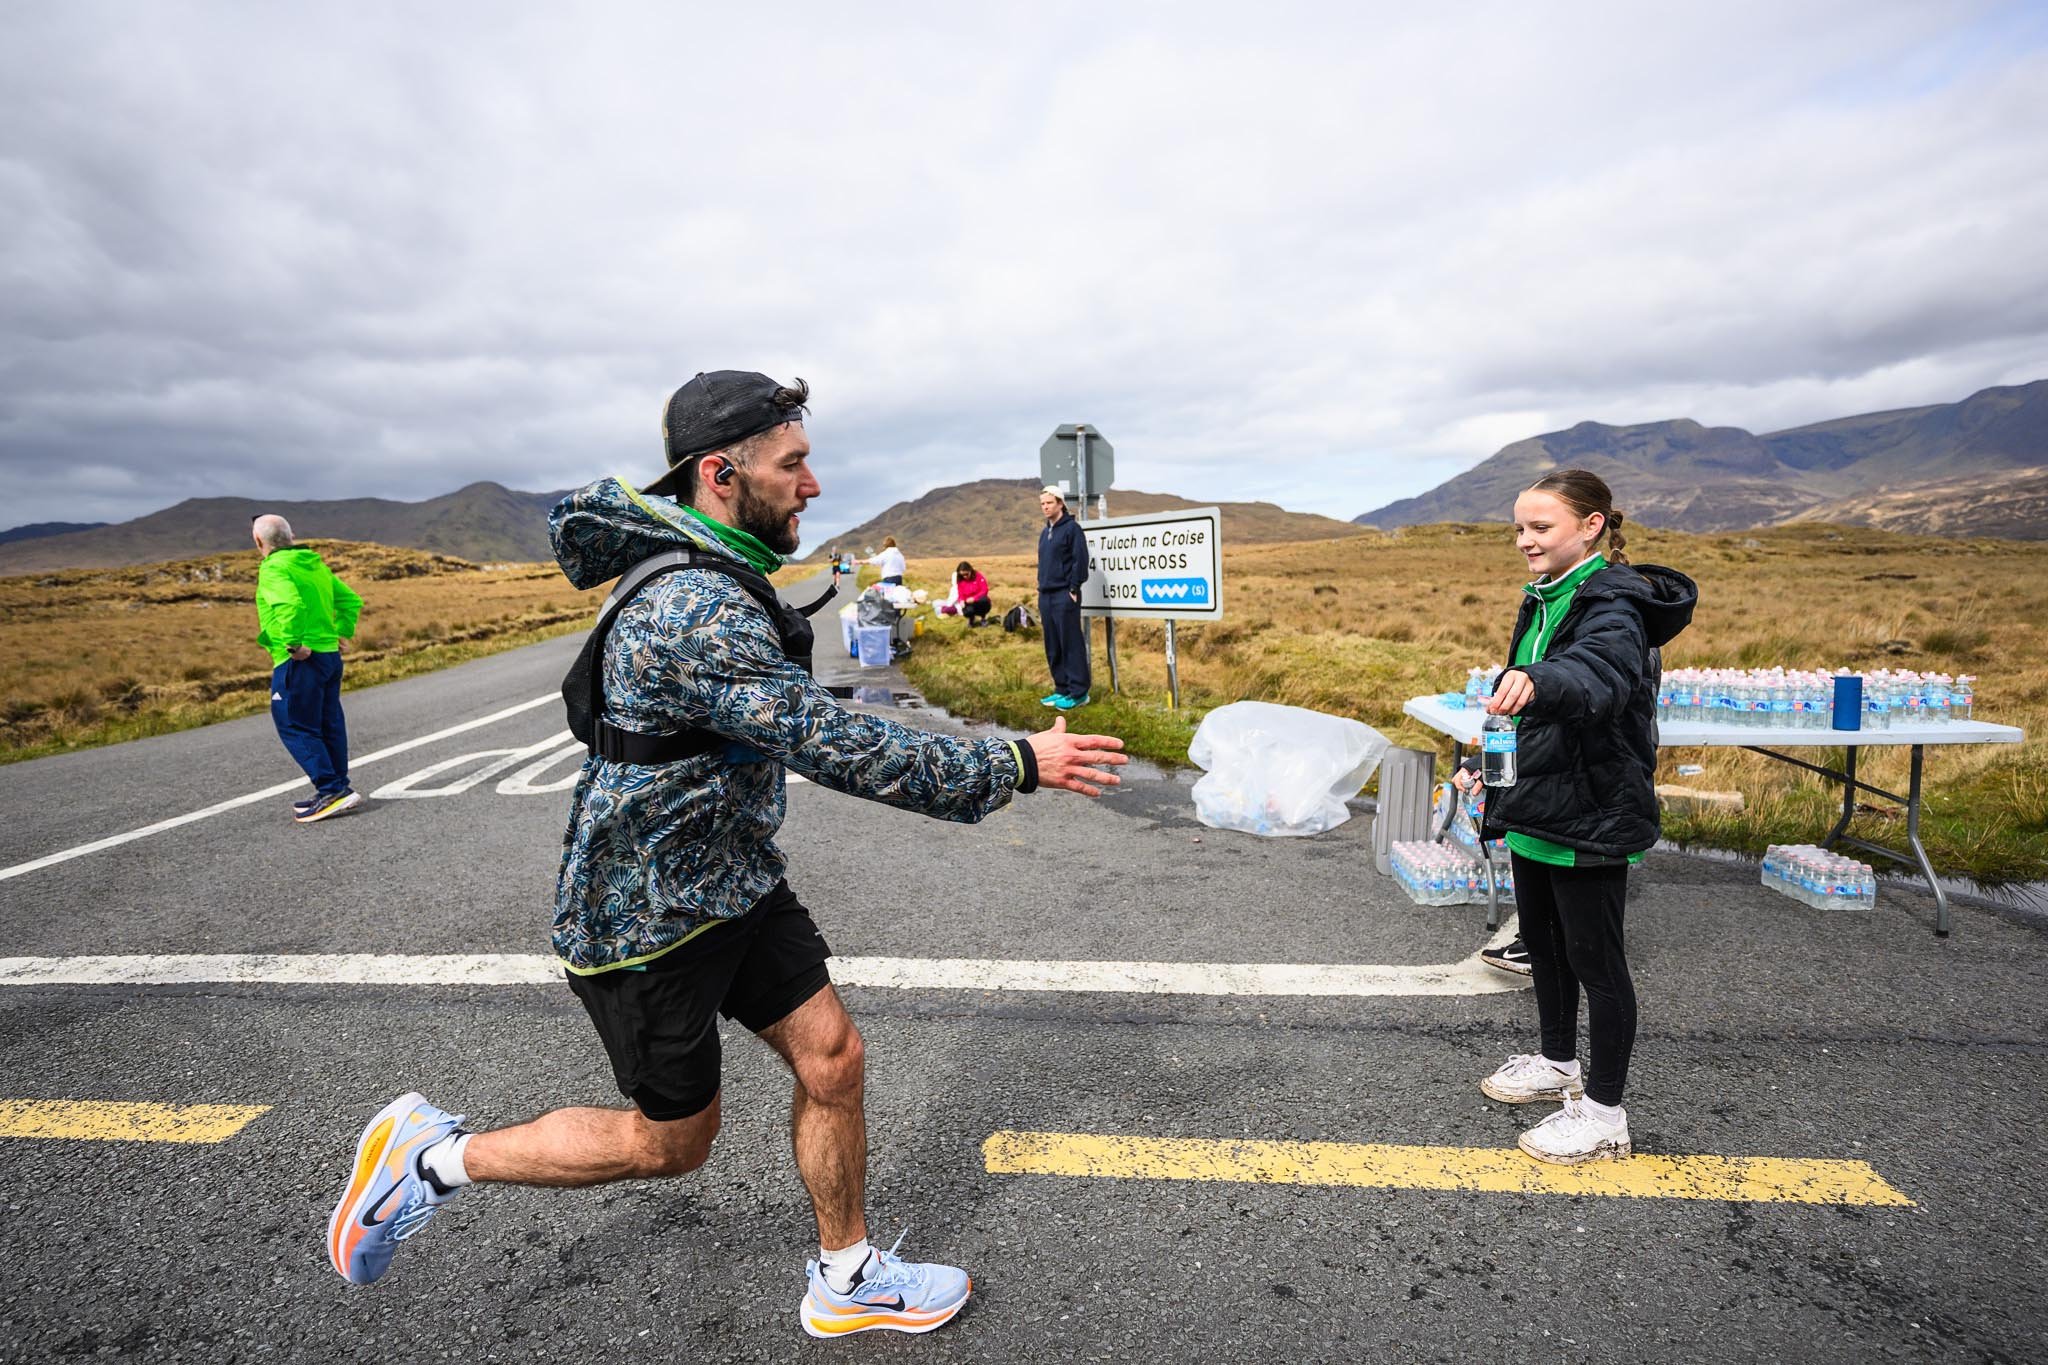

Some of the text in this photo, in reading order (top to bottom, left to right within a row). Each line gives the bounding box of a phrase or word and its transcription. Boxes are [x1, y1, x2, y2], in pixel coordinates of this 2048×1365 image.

[1100, 534, 1137, 550] Tulach
[1142, 536, 1157, 547] na
[1162, 530, 1205, 546] Croise
[1101, 553, 1187, 571] TULLYCROSS
[1102, 584, 1205, 599] L5102 (S)
